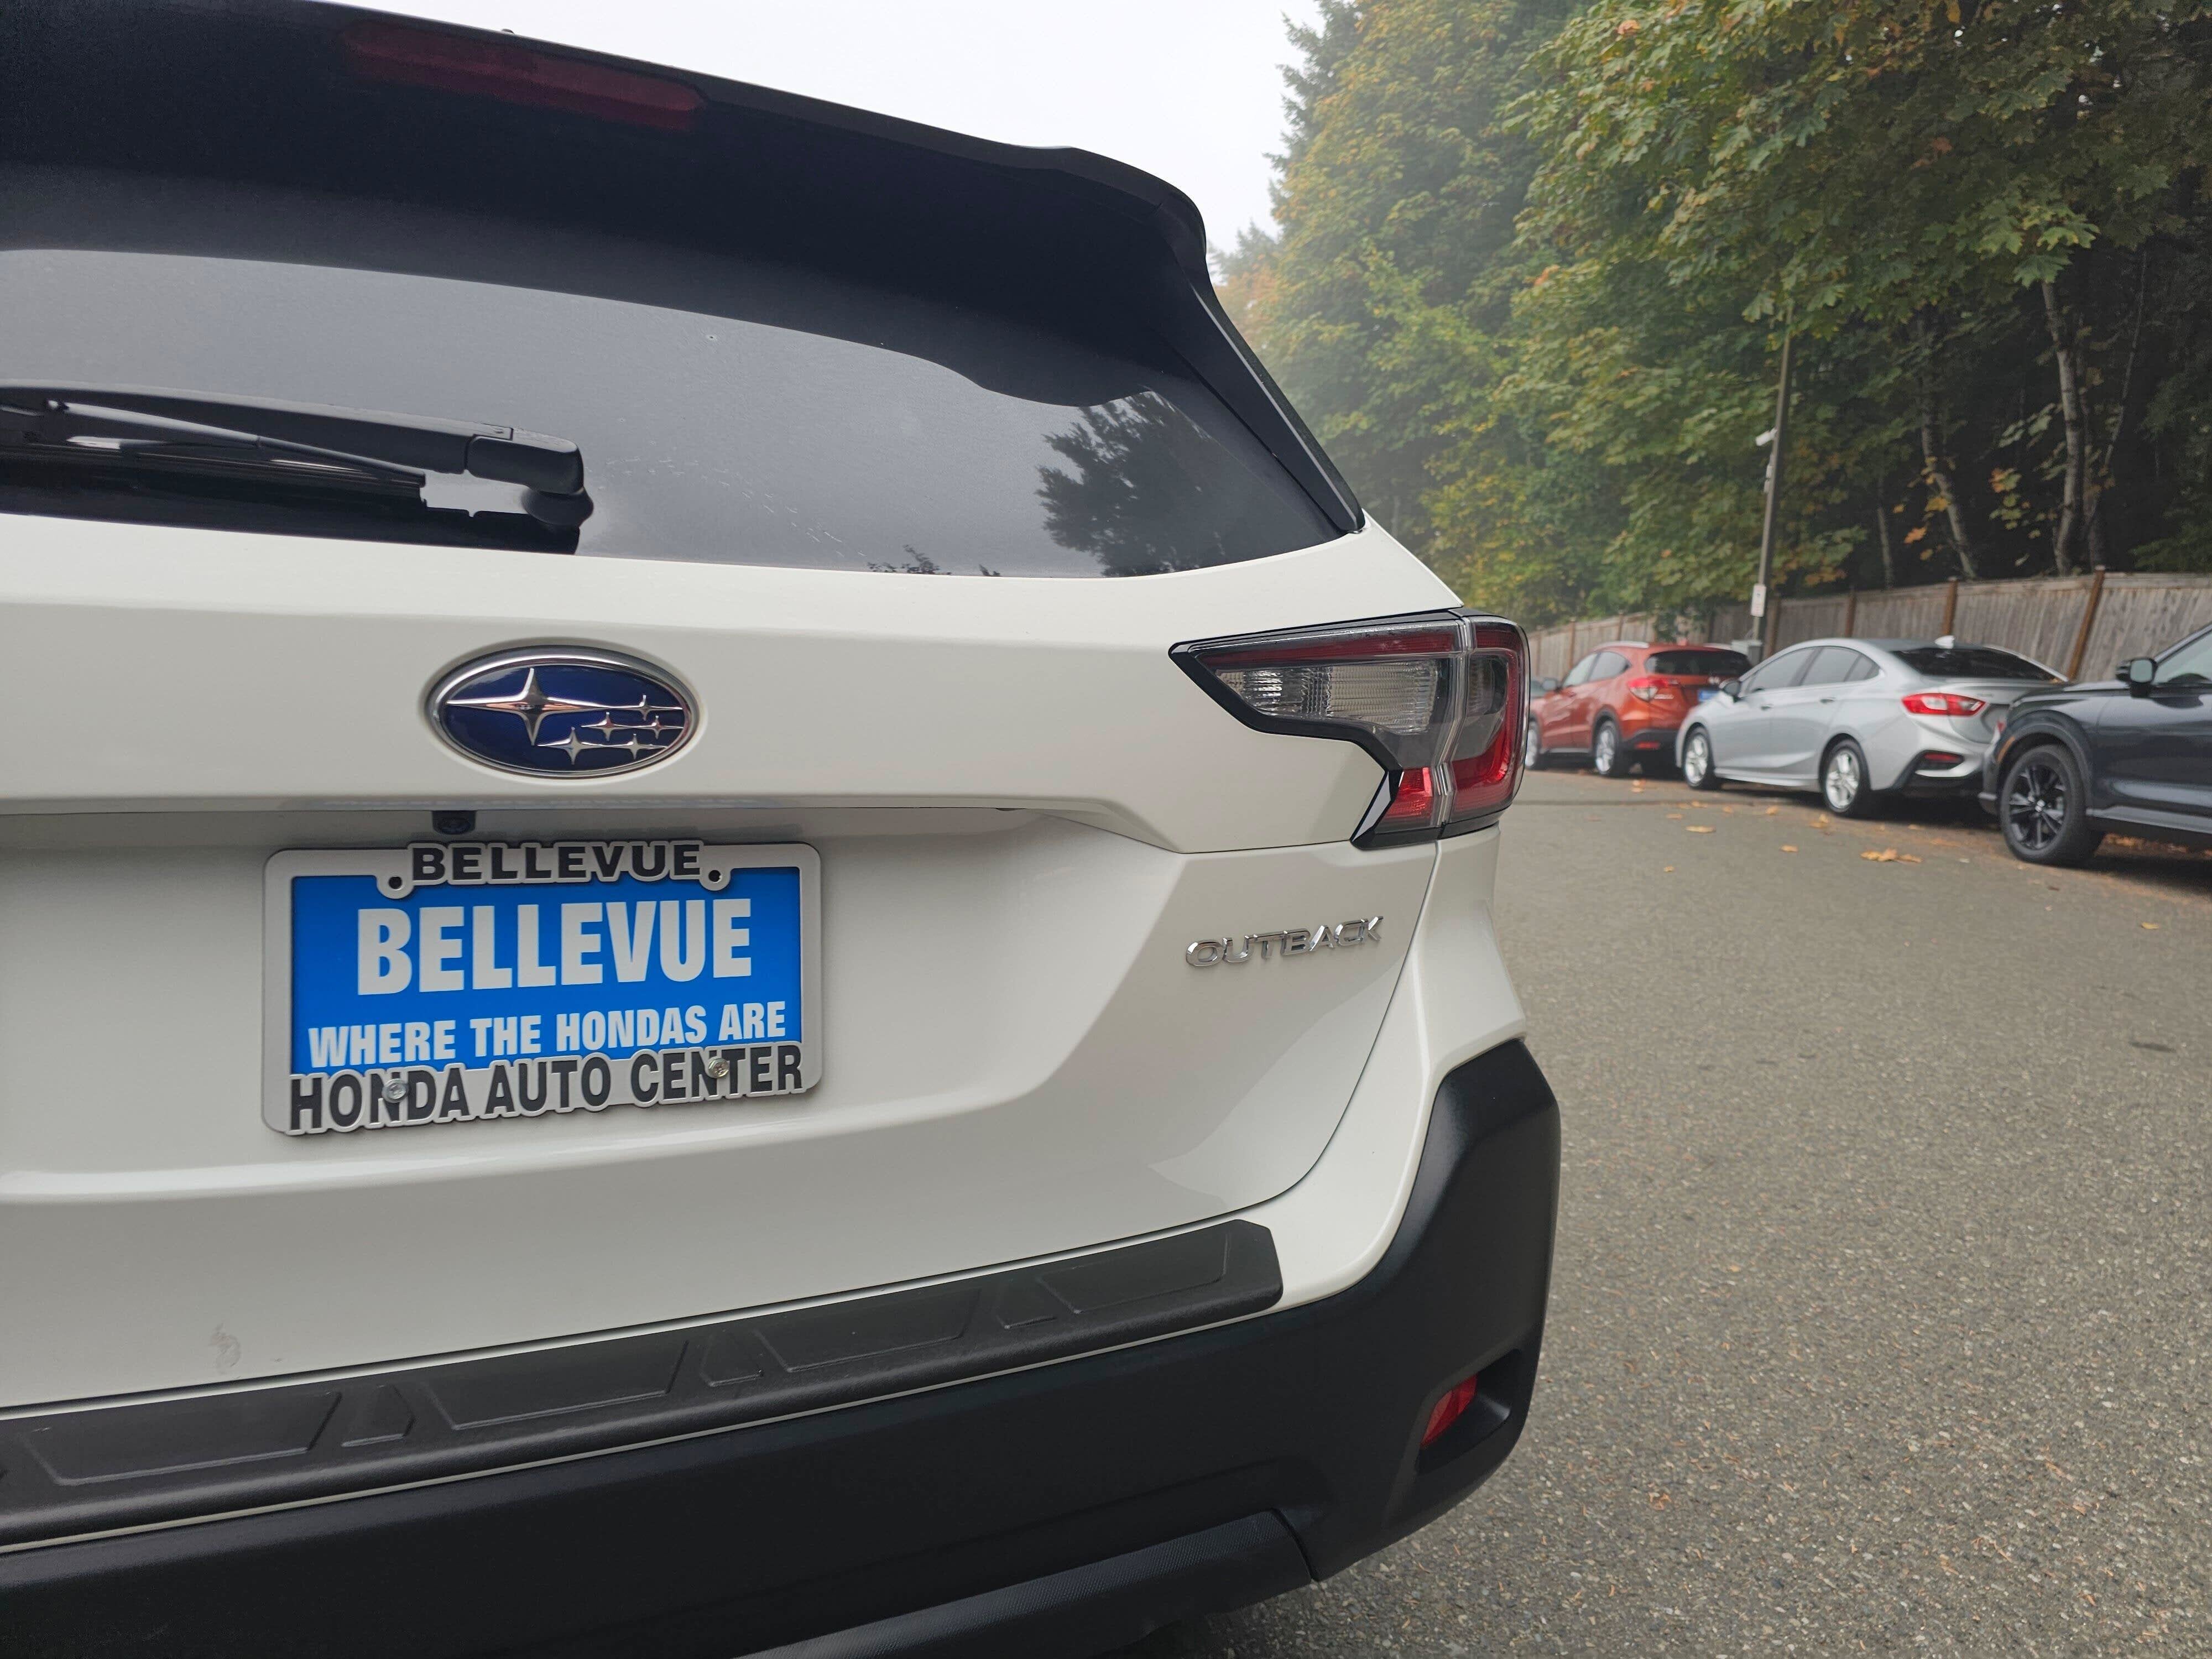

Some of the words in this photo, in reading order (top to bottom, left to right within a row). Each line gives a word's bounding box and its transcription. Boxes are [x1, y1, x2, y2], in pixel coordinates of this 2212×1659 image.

[411, 844, 701, 881] BELLEVUE
[357, 899, 752, 995] BELLEVUE
[1186, 916, 1384, 967] OUTBACK
[308, 1019, 457, 1067] WHERE
[470, 1016, 541, 1057] THE
[556, 1005, 706, 1052] HONDAS
[718, 1001, 786, 1041] ARE
[289, 1068, 471, 1130] HONDA
[487, 1056, 611, 1114] AUTO
[630, 1045, 803, 1098] CENTER
